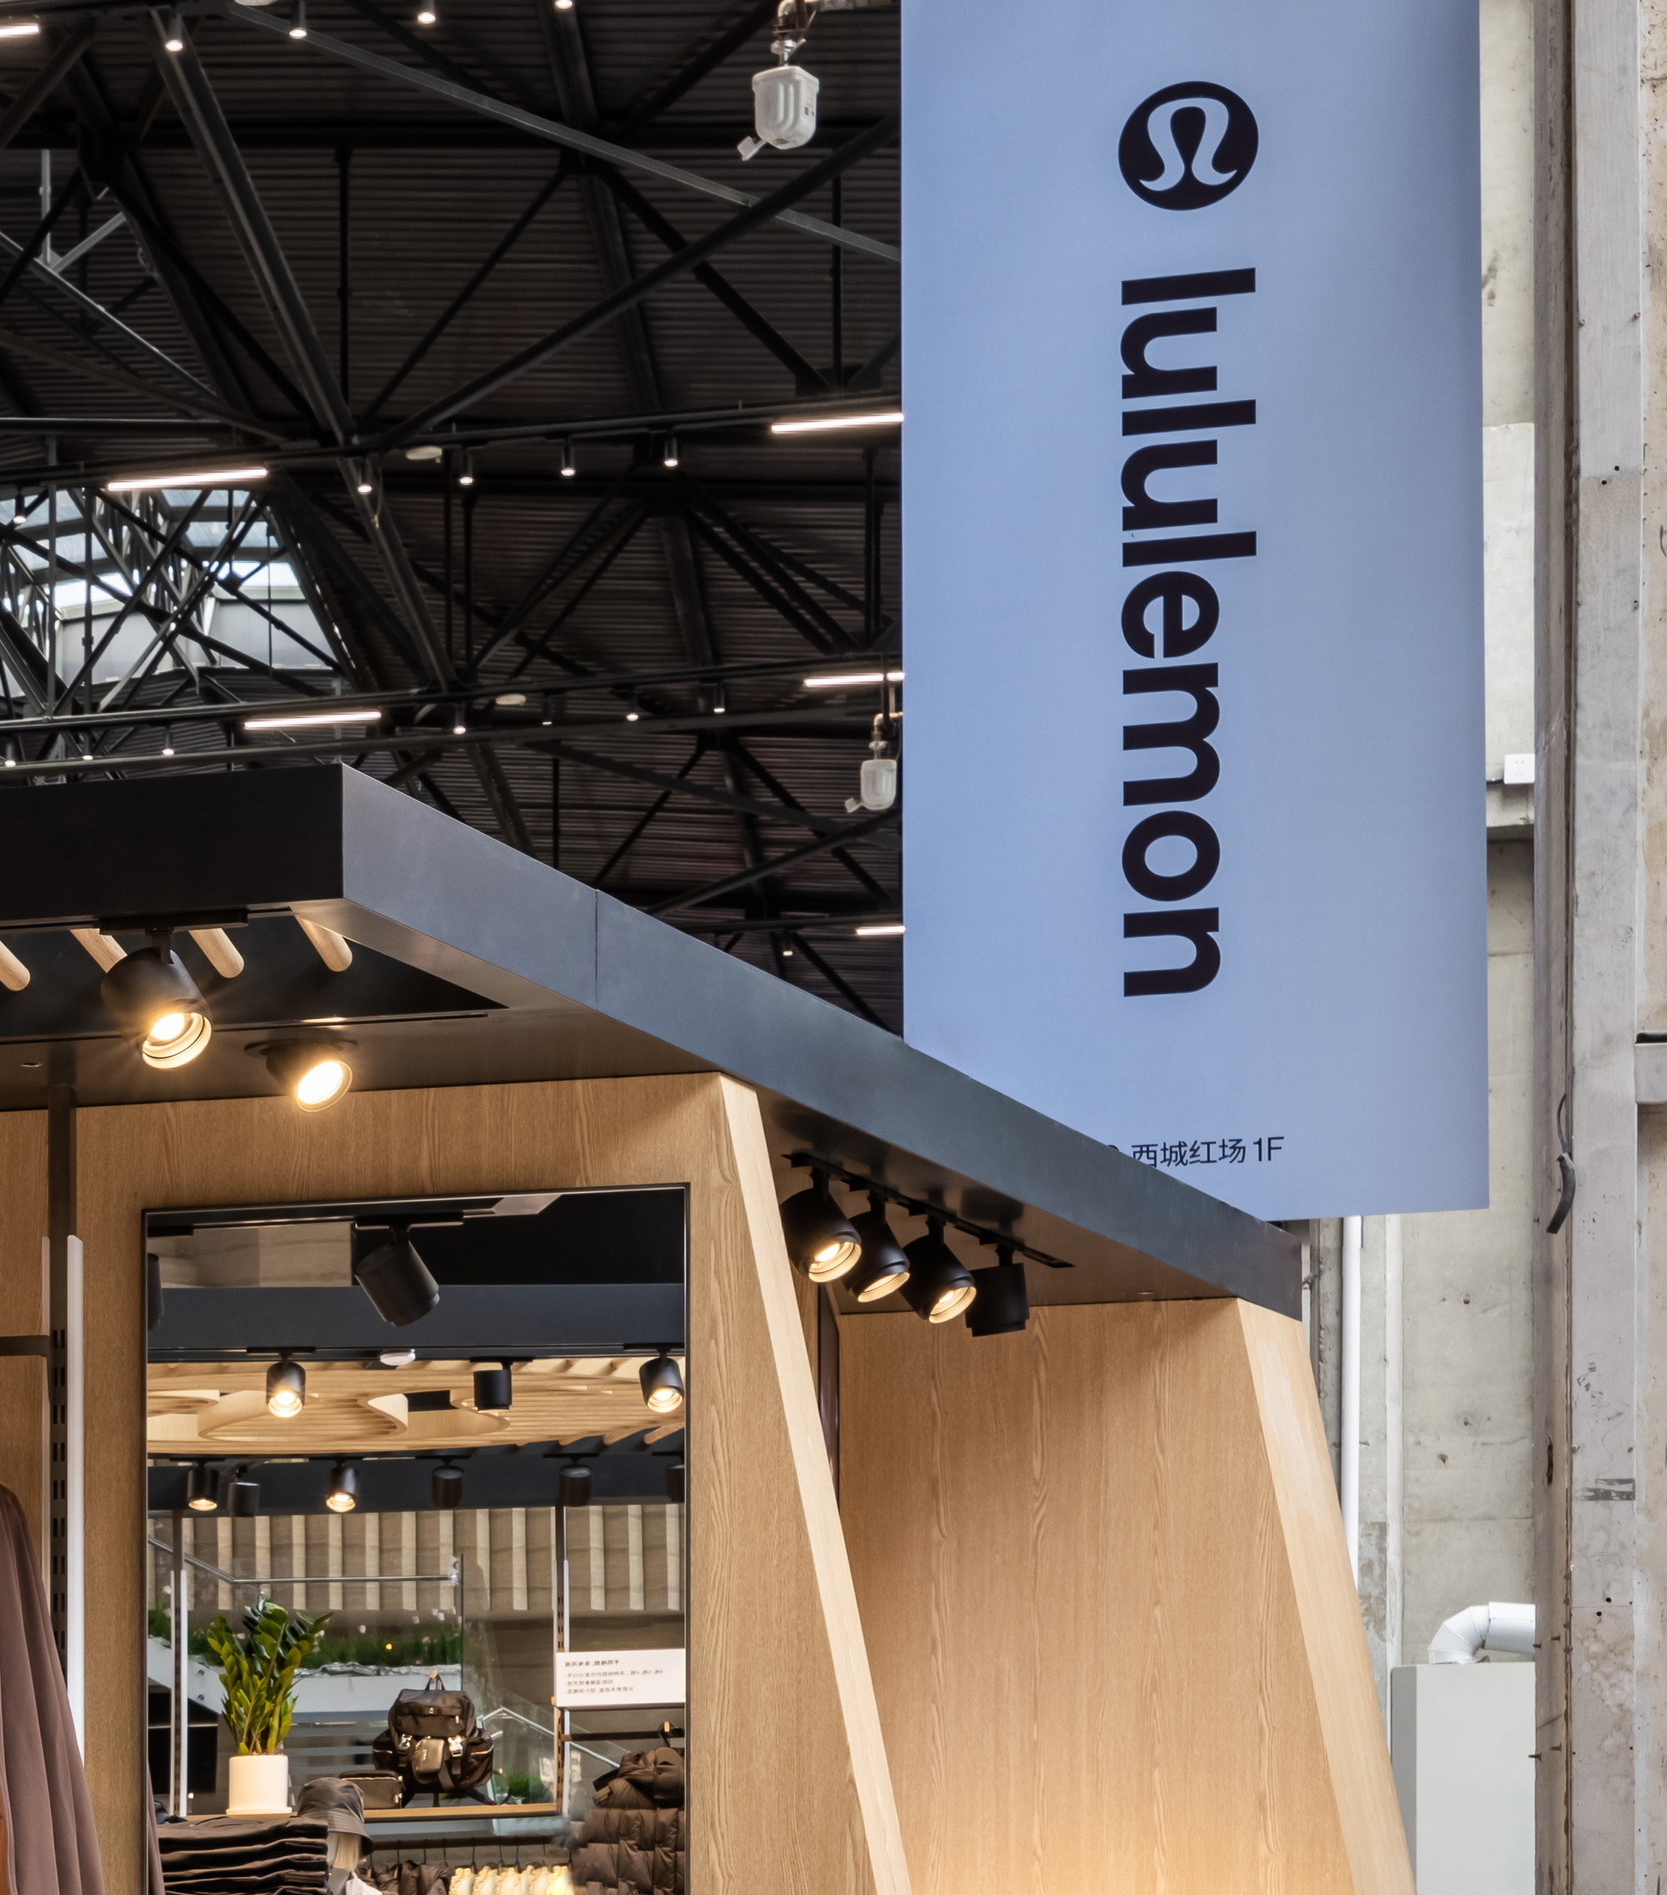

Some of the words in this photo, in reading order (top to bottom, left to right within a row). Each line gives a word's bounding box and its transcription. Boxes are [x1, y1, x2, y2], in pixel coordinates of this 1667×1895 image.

[1120, 267, 1258, 998] lululemon
[1131, 1139, 1246, 1169] 西城红场
[1253, 1136, 1285, 1163] 1F
